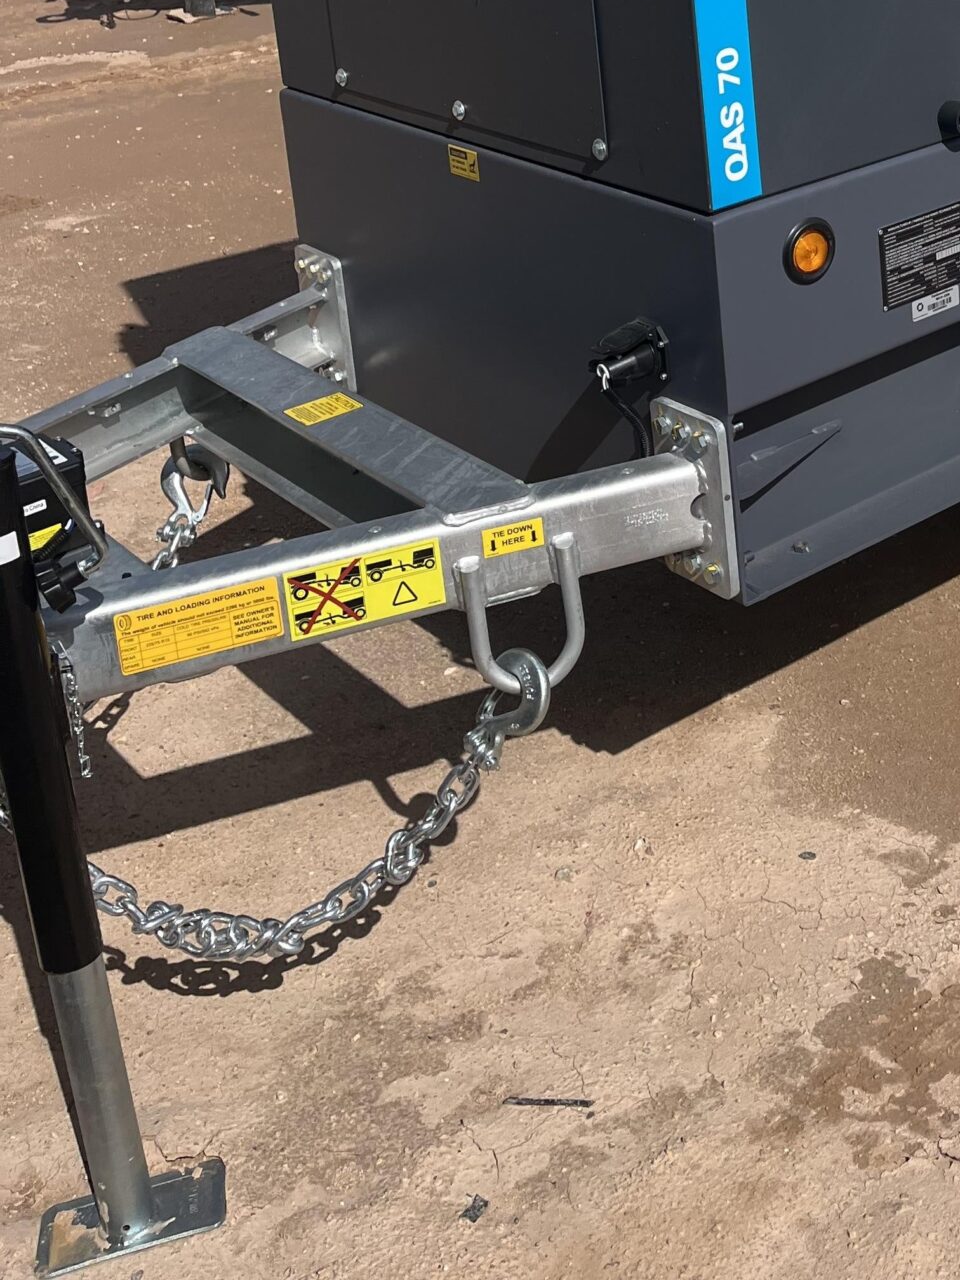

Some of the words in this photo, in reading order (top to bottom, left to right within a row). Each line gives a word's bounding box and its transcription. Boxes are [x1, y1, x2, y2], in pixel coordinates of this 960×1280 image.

[716, 47, 741, 94] 70
[720, 102, 748, 182] QAS
[492, 530, 505, 538] TIE
[507, 524, 532, 535] DOWN
[502, 536, 525, 546] HERE
[136, 612, 154, 622] TIRE
[157, 608, 173, 617] AND
[175, 599, 210, 612] LOADING
[212, 586, 265, 602] INFORMATION
[234, 618, 260, 626] MANUAL
[235, 625, 277, 638] INFORMATION
